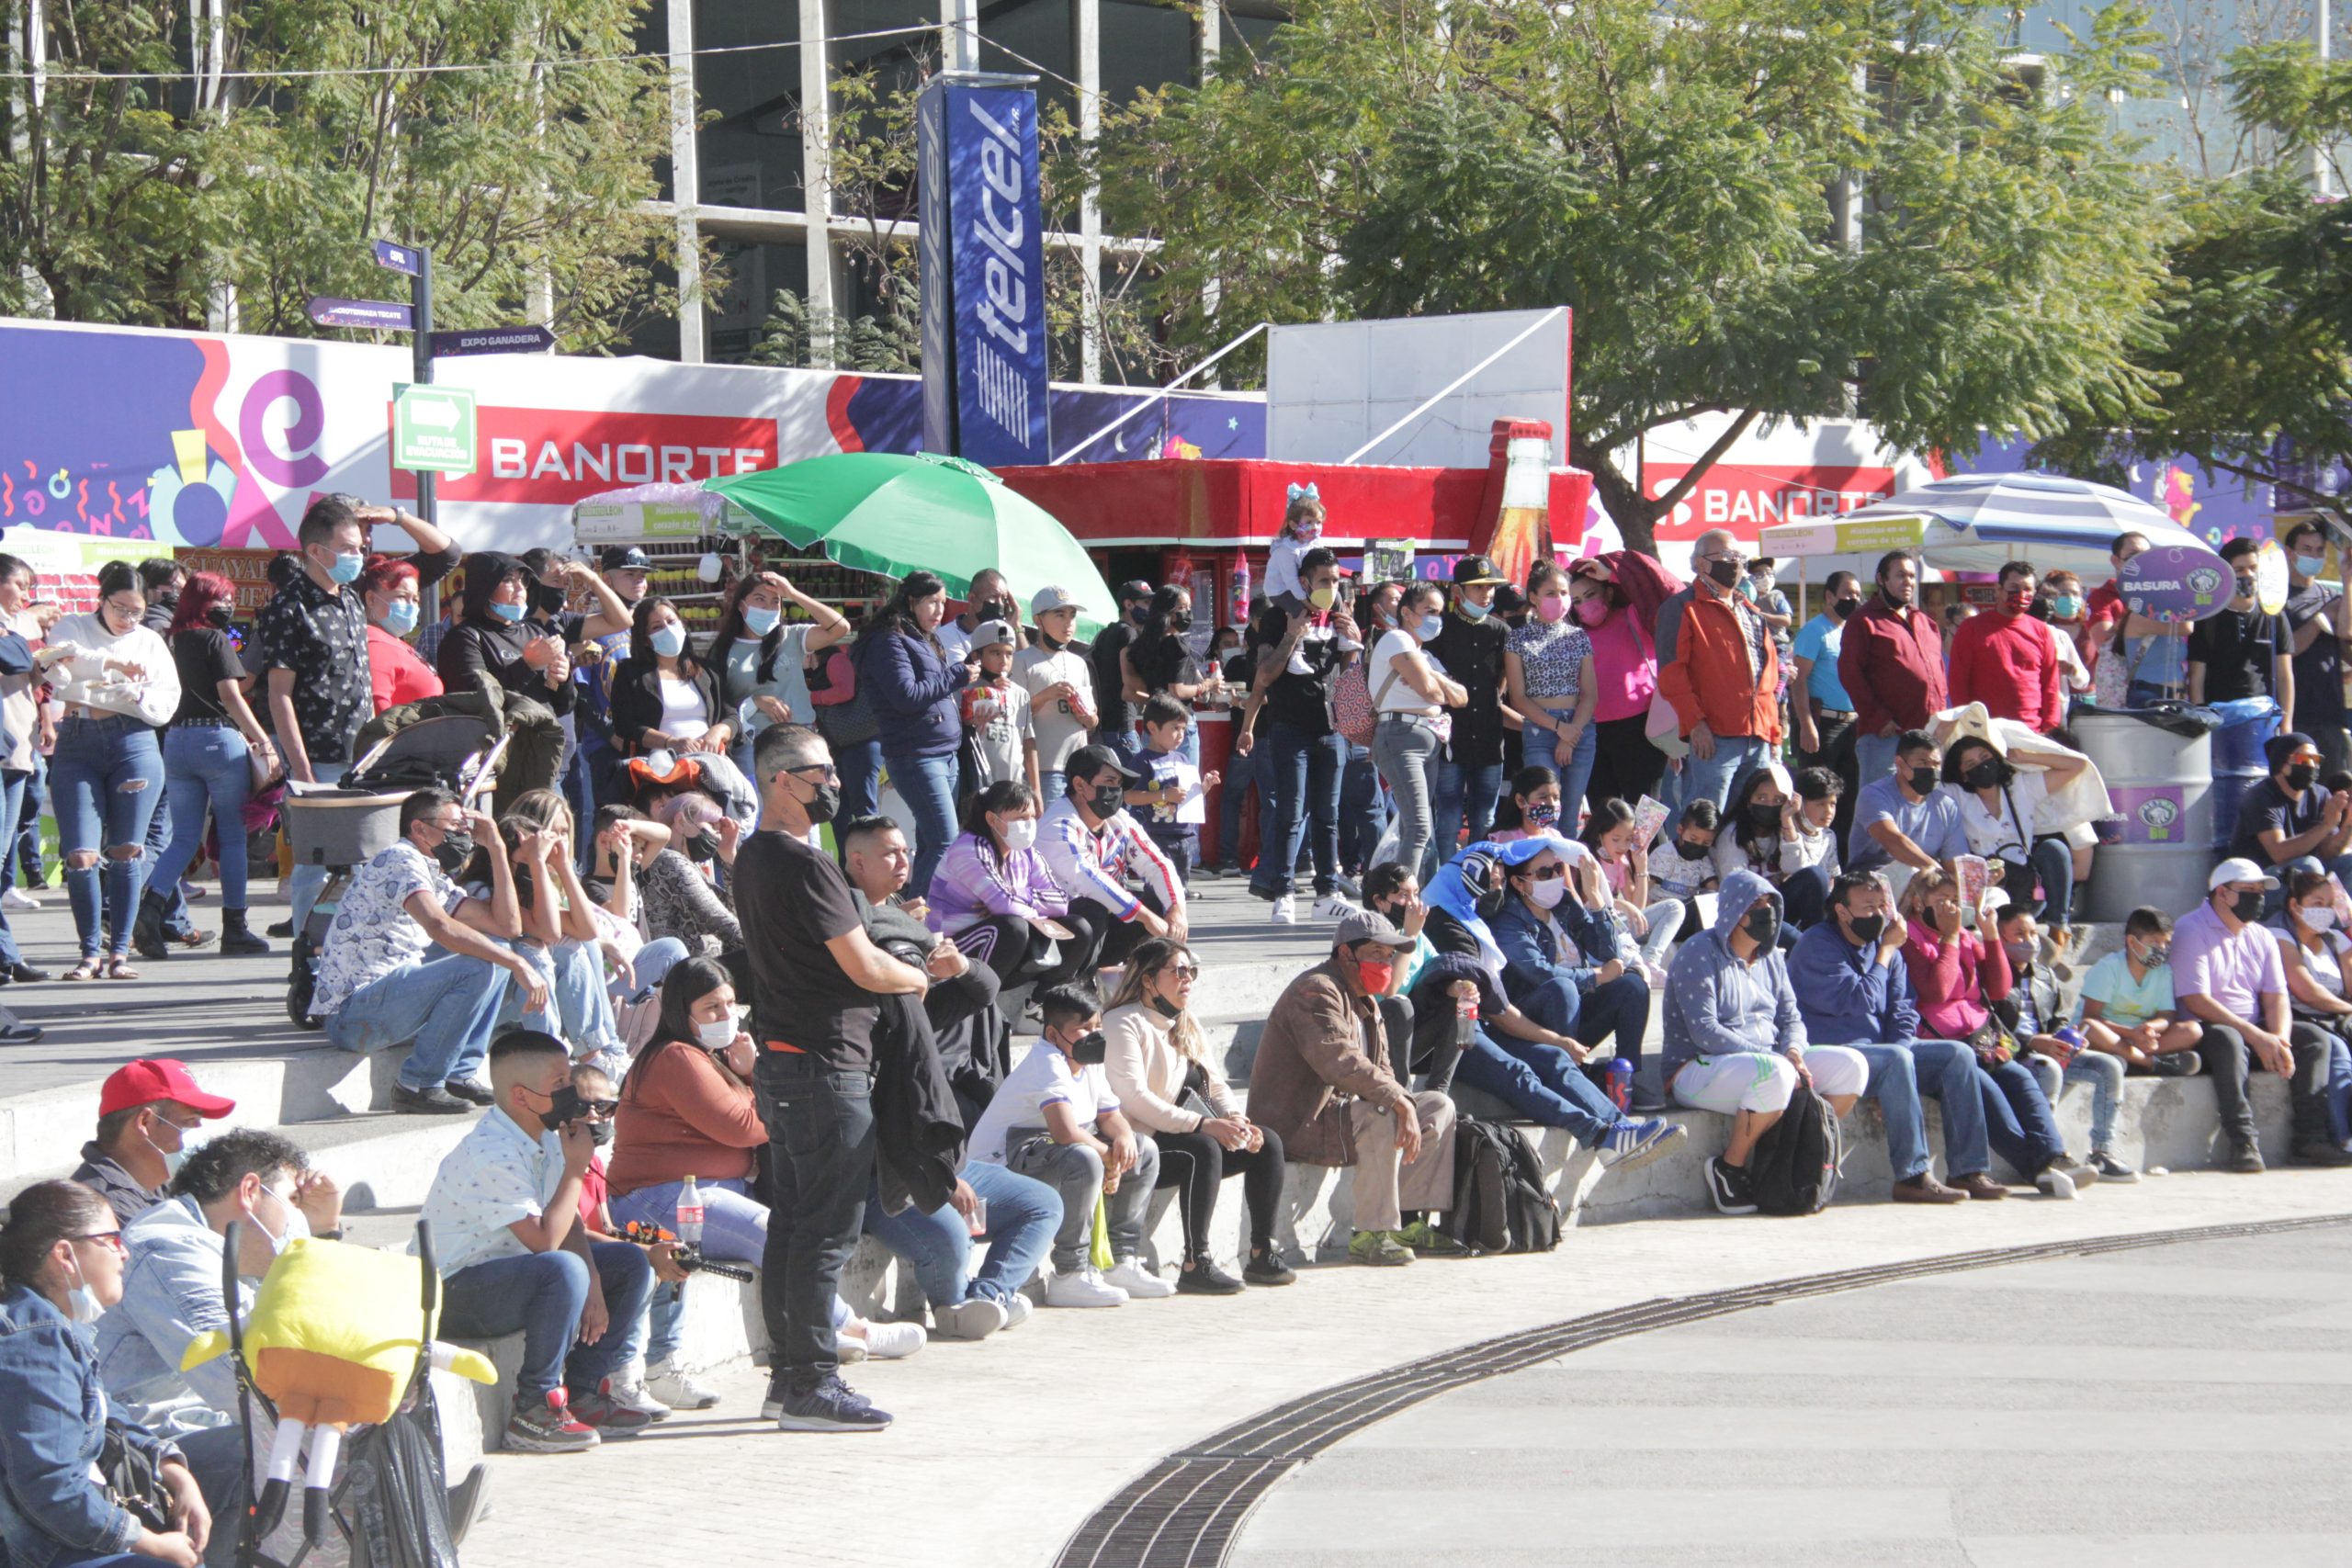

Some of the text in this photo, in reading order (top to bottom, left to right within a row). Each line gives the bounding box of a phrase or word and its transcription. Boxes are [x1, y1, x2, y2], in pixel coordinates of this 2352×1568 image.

[922, 107, 942, 349] telcel
[969, 97, 1028, 355] telcel
[460, 333, 540, 347] EXPO GANADERA
[492, 437, 765, 483] BANORTE
[2122, 581, 2181, 592] BASURA
